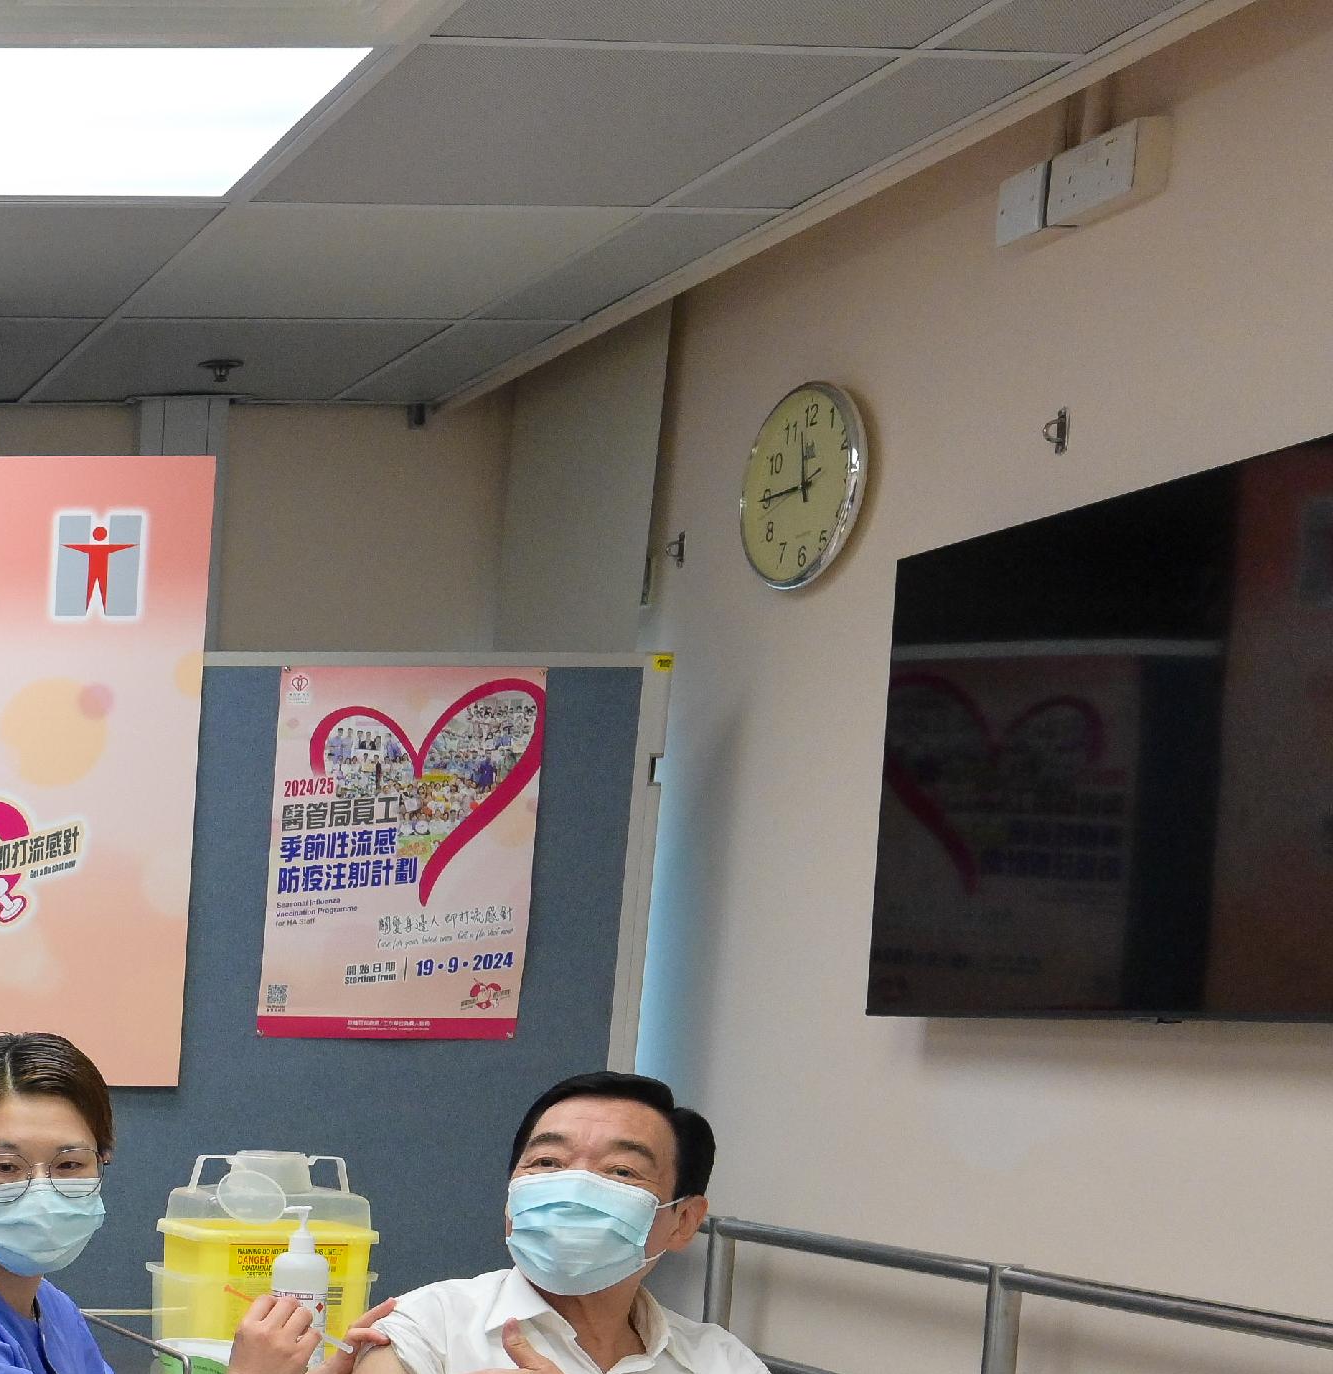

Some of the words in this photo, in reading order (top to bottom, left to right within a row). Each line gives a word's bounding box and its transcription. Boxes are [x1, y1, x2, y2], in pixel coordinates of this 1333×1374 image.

[804, 403, 819, 427] 12
[829, 407, 836, 429] 1
[784, 422, 798, 445] 11
[768, 452, 783, 476] 10
[762, 488, 772, 510] 9
[765, 521, 774, 542] 8
[779, 542, 788, 564] 7
[797, 545, 807, 567] 6
[283, 777, 334, 798] 2024/25
[281, 796, 400, 832] 醫管局員工
[279, 827, 398, 864] 季節性流感
[277, 856, 418, 895] 防疫注射計劃
[344, 974, 376, 985] Starting
[346, 961, 396, 976] 開始日期
[237, 1255, 270, 1264] DANGER
